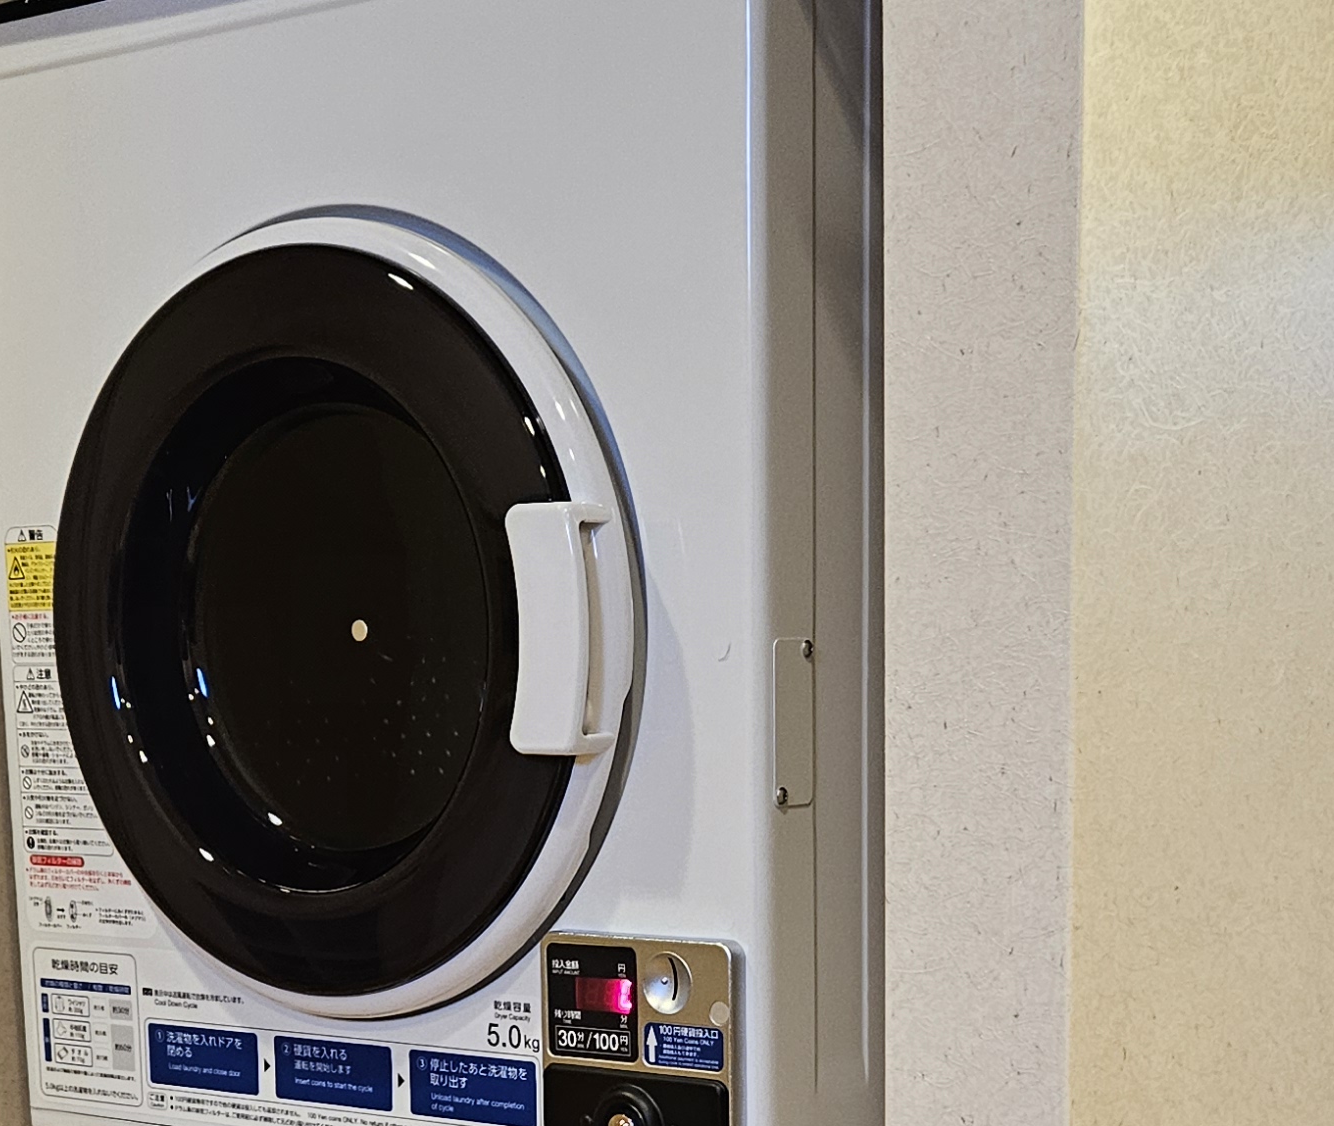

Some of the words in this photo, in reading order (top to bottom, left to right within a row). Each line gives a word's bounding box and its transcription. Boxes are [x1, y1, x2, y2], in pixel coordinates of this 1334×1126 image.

[28, 529, 43, 541] 警告
[36, 668, 52, 680] 注意
[51, 958, 119, 975] 乾燥時間の目安
[551, 959, 579, 970] 投入金額
[617, 963, 626, 973] 円
[167, 999, 183, 1007] Down
[183, 1001, 198, 1010] Cycle
[493, 1000, 532, 1014] 乾燥容量
[494, 1012, 508, 1020] Dryer
[508, 1013, 531, 1023] Capacity
[554, 1009, 582, 1020] 残り時間
[620, 1014, 627, 1024] 分
[487, 1022, 540, 1053] 5.0kg
[658, 1025, 719, 1040] 100円硬貨投入口
[166, 1030, 243, 1050] 洗濯物を入れドアを
[699, 1039, 714, 1047] ONLY
[167, 1044, 193, 1058] 閉める
[293, 1043, 348, 1061] 硬貨を入れる
[168, 1062, 182, 1070] Load
[182, 1063, 202, 1074] laundry
[228, 1069, 241, 1077] door
[293, 1060, 352, 1075] 運転を開始します
[430, 1058, 528, 1081] 停止したあと洗濯物を
[294, 1077, 310, 1086] Insert
[326, 1080, 334, 1088] to
[334, 1082, 347, 1090] start
[347, 1083, 357, 1091] the
[358, 1084, 374, 1094] cycle
[430, 1072, 468, 1089] 取り出す
[430, 1092, 452, 1101] Unload
[452, 1094, 475, 1106] laundry
[476, 1098, 490, 1106] after
[490, 1100, 525, 1111] completion
[431, 1102, 438, 1110] of
[438, 1104, 454, 1113] cycle
